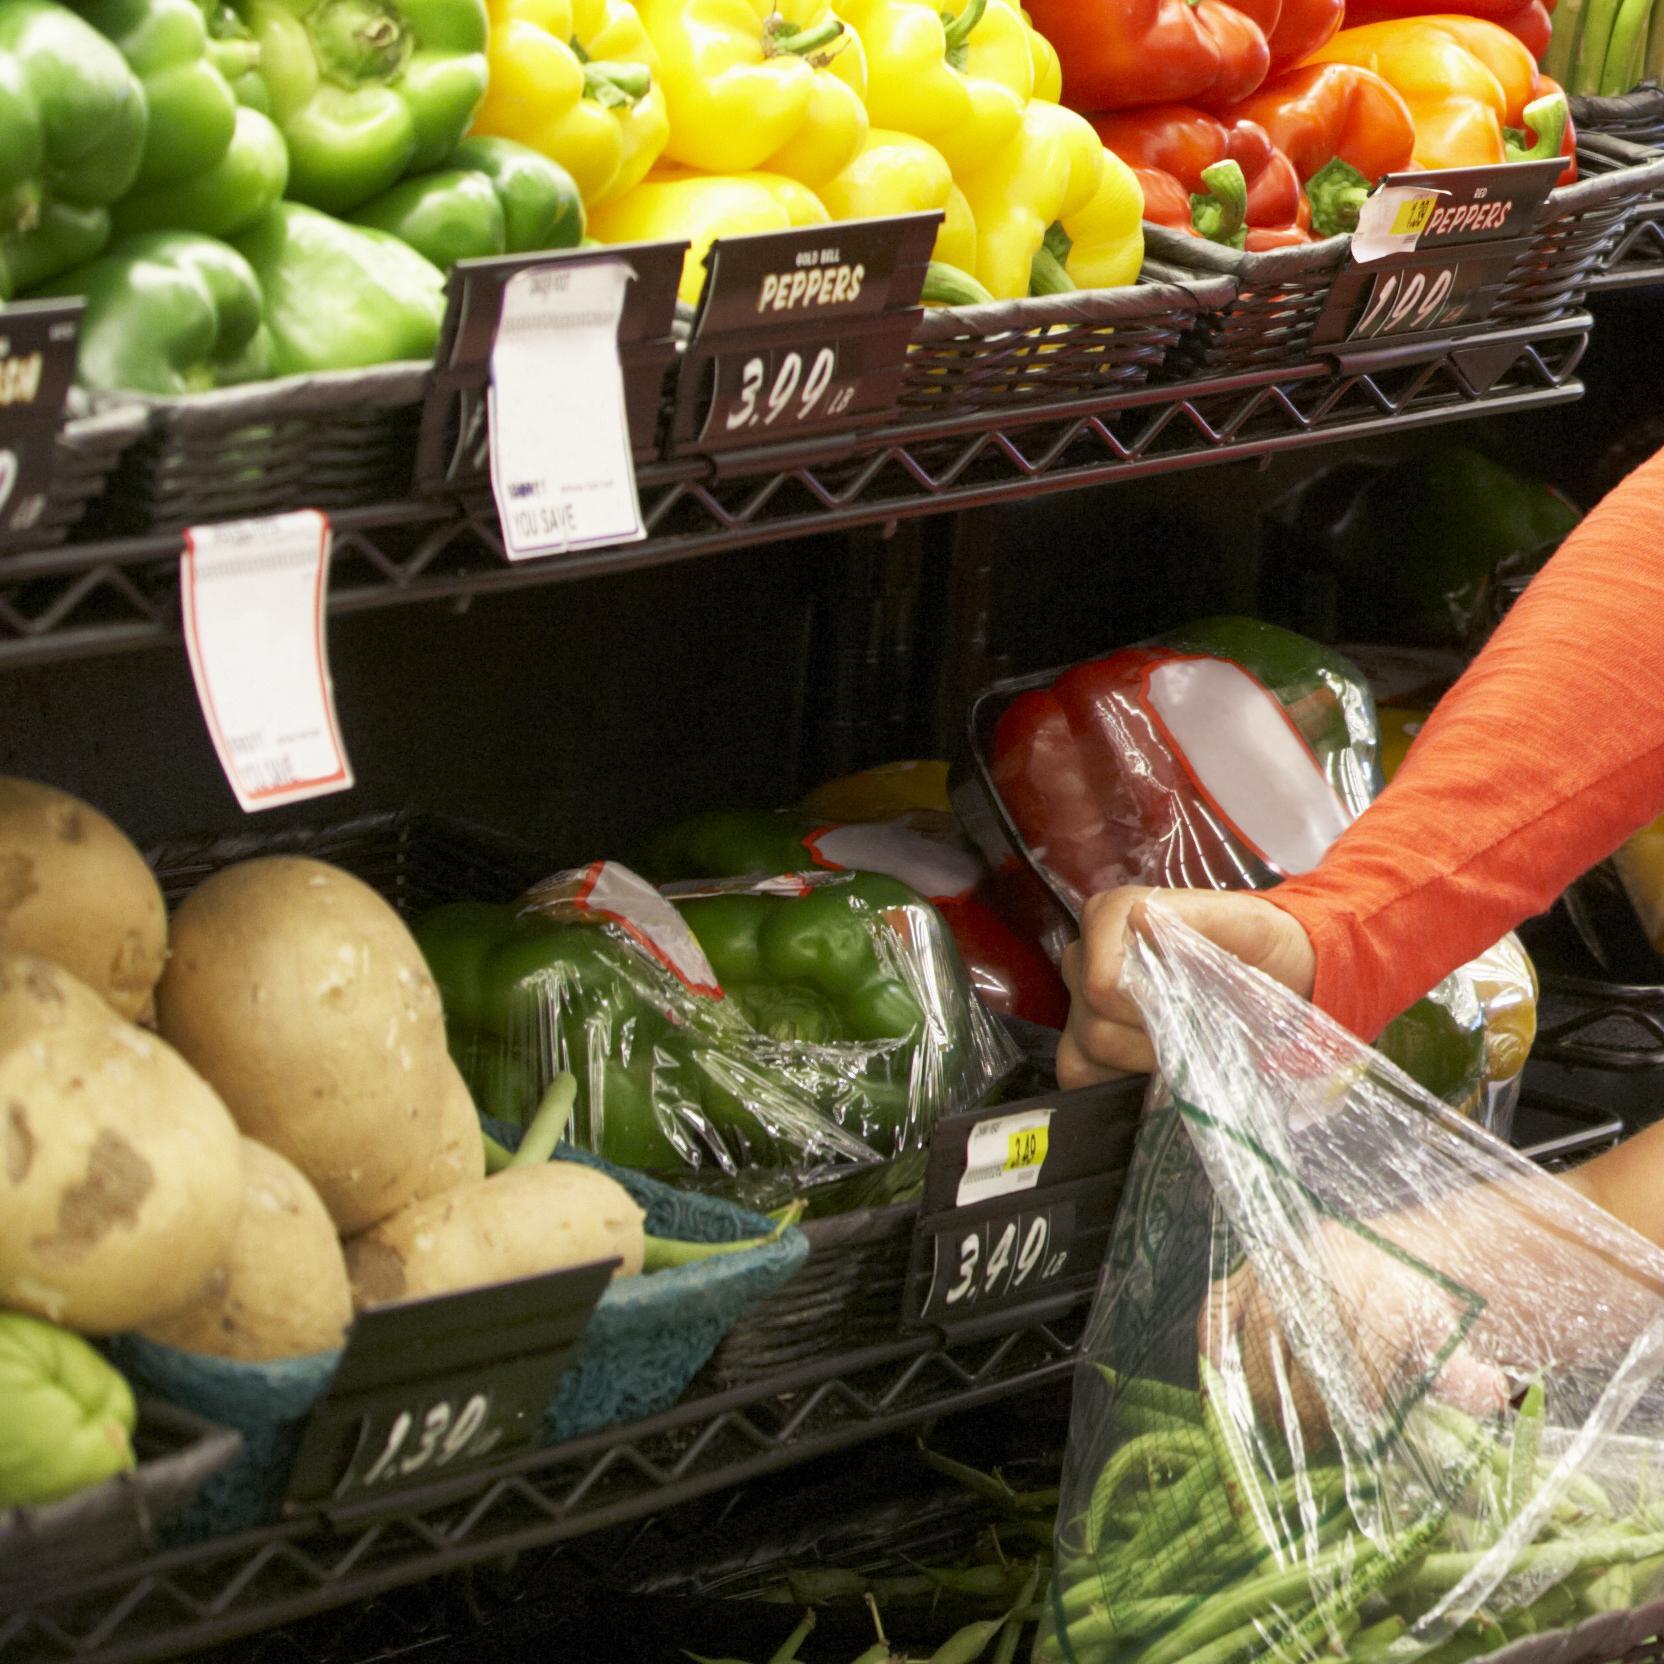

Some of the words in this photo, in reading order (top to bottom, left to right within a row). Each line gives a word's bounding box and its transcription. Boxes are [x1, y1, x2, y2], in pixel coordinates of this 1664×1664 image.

[1424, 200, 1512, 236] PEPPERS
[758, 263, 865, 314] PEPPERS
[726, 348, 834, 430] 3.99
[540, 503, 577, 534] SAVE
[946, 1216, 1047, 1305] 3.49
[363, 1394, 487, 1486] 1.39
